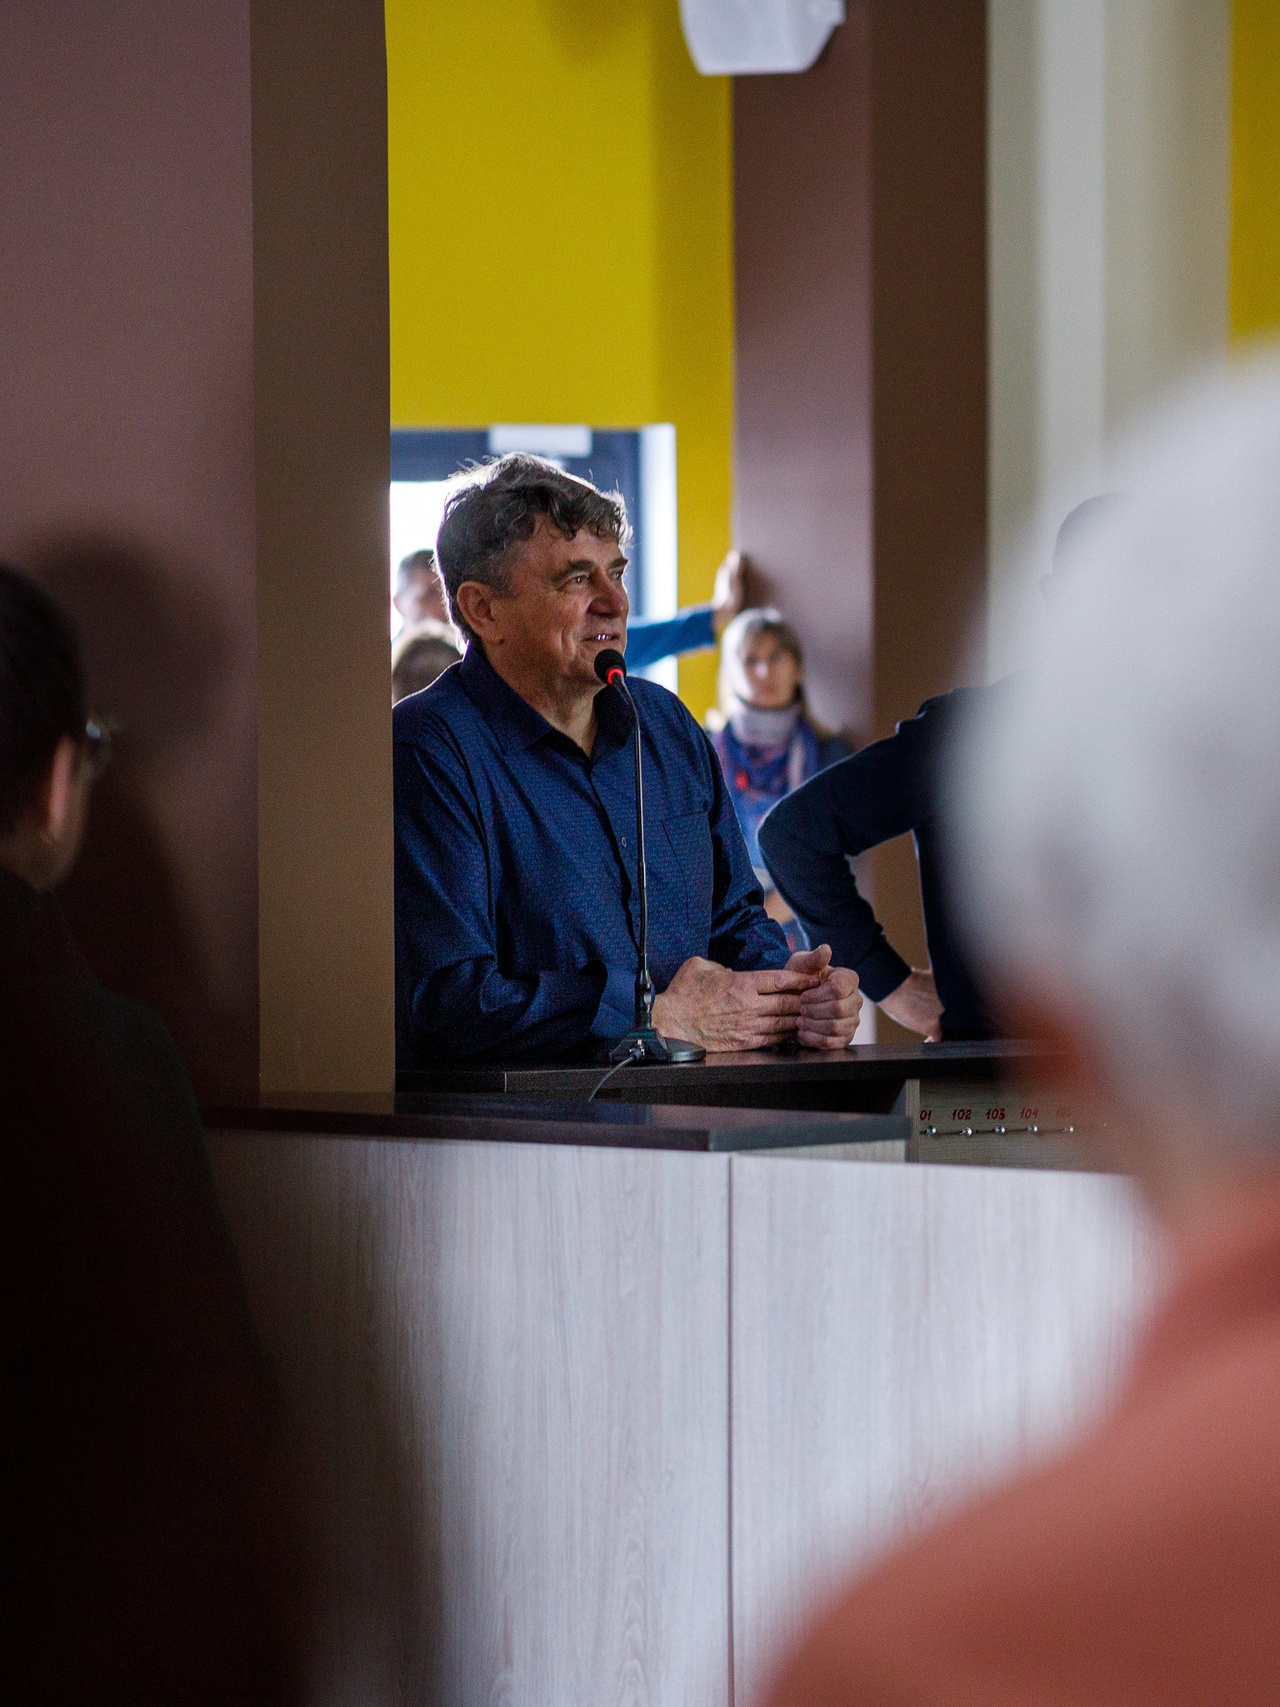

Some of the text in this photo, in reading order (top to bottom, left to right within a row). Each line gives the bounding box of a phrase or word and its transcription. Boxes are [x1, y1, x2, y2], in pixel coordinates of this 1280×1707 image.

[919, 1110, 932, 1121] 01
[952, 1109, 972, 1120] 102
[986, 1108, 1006, 1120] 103
[1020, 1108, 1039, 1120] 104
